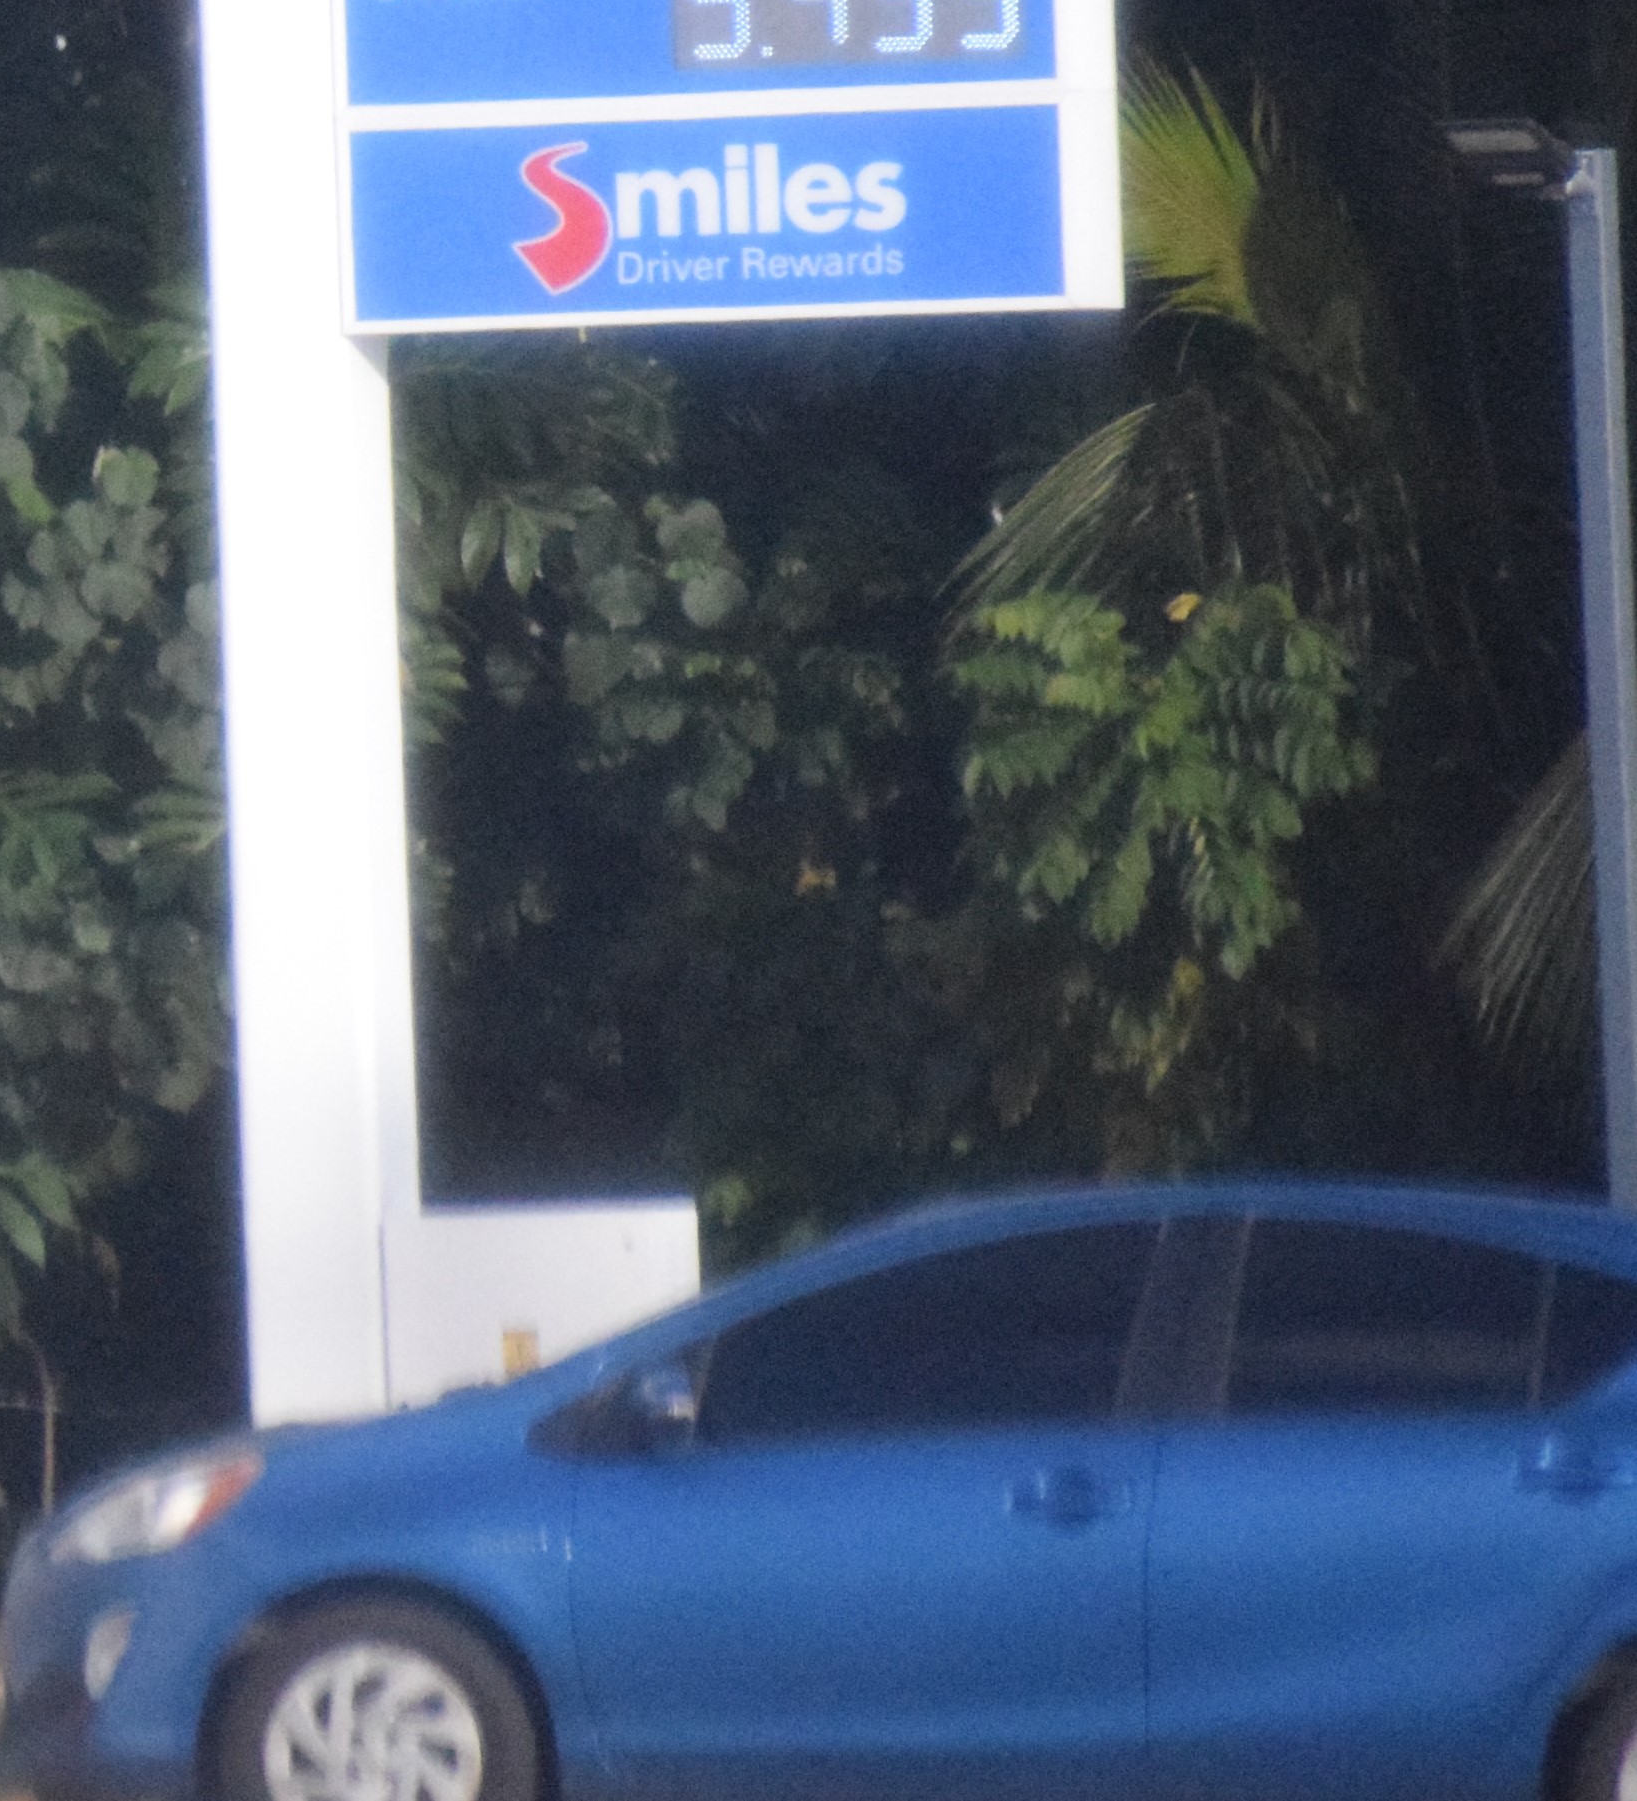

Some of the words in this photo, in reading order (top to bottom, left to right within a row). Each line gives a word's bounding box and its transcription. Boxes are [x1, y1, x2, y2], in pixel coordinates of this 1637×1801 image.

[512, 140, 908, 296] Smiles
[617, 246, 729, 286] Driver
[741, 242, 905, 281] Rewards
